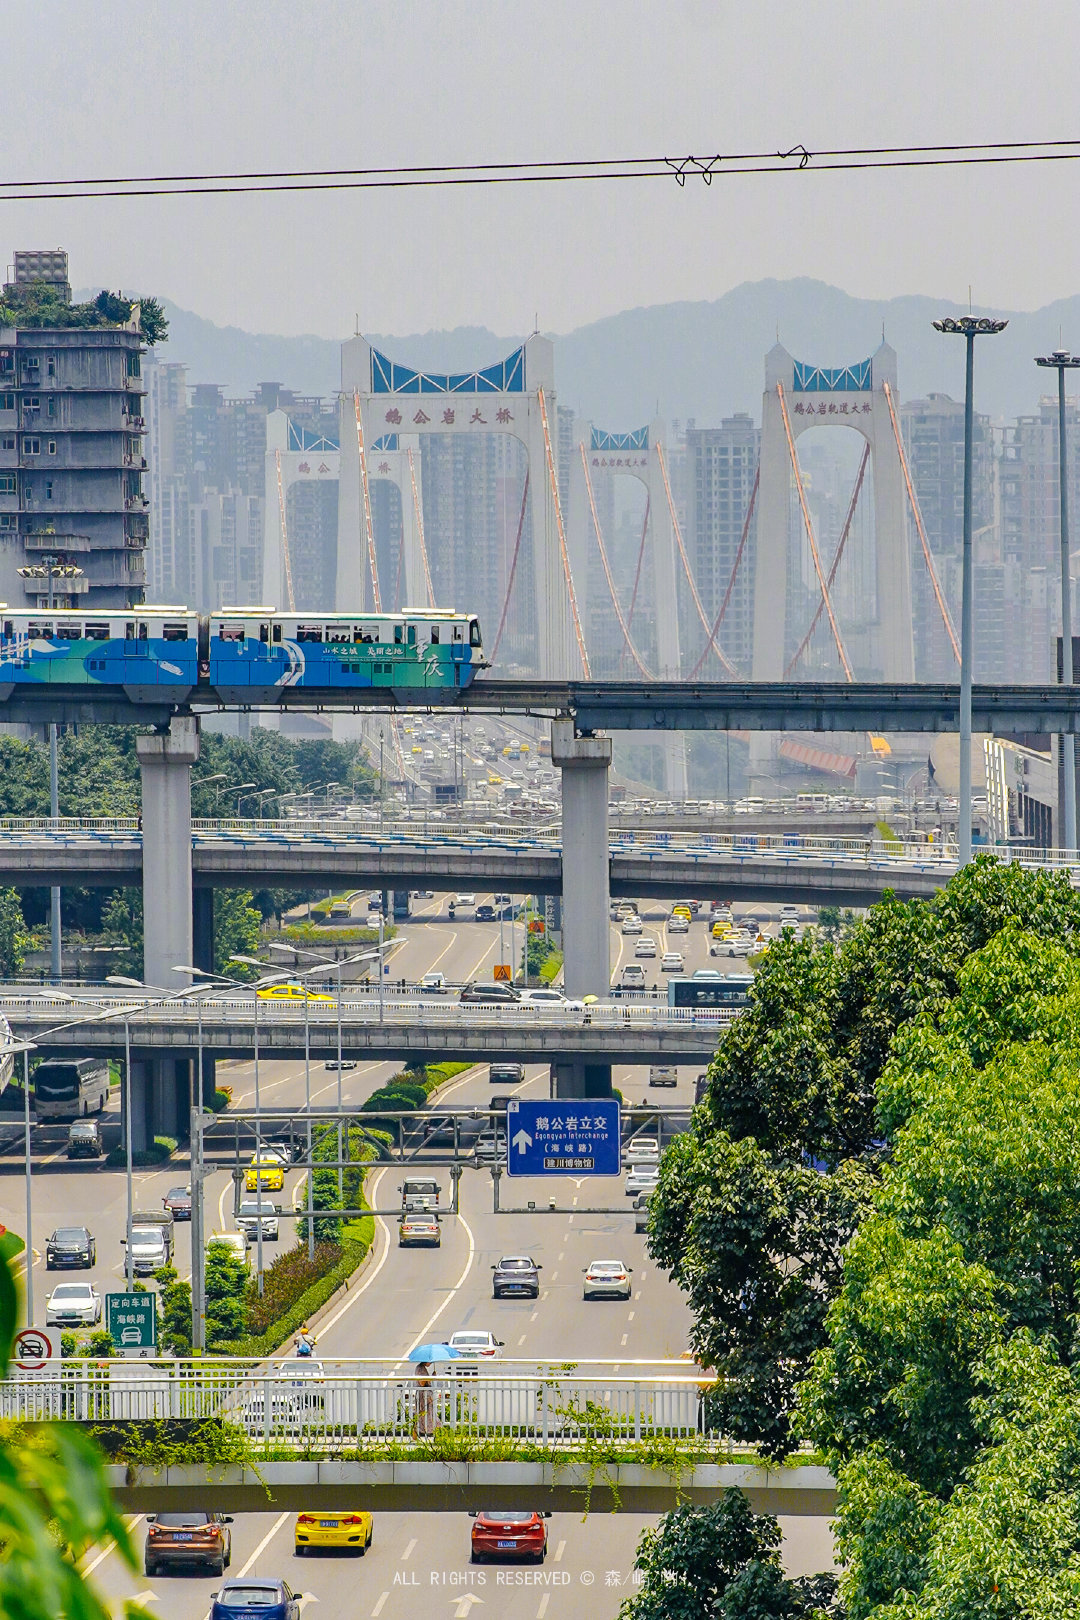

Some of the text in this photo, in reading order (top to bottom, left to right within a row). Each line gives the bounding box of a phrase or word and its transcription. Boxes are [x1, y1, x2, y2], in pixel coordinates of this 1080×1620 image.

[385, 407, 515, 425] 鹅公岩大桥
[323, 647, 404, 657] 山水之城 美丽之地
[535, 1116, 608, 1131] 鹅公岩立交
[535, 1132, 609, 1141] Egongyan Interchange
[547, 1159, 593, 1168] 建川博物馆
[111, 1297, 151, 1308] 定向车道
[116, 1314, 146, 1325] 海峡路
